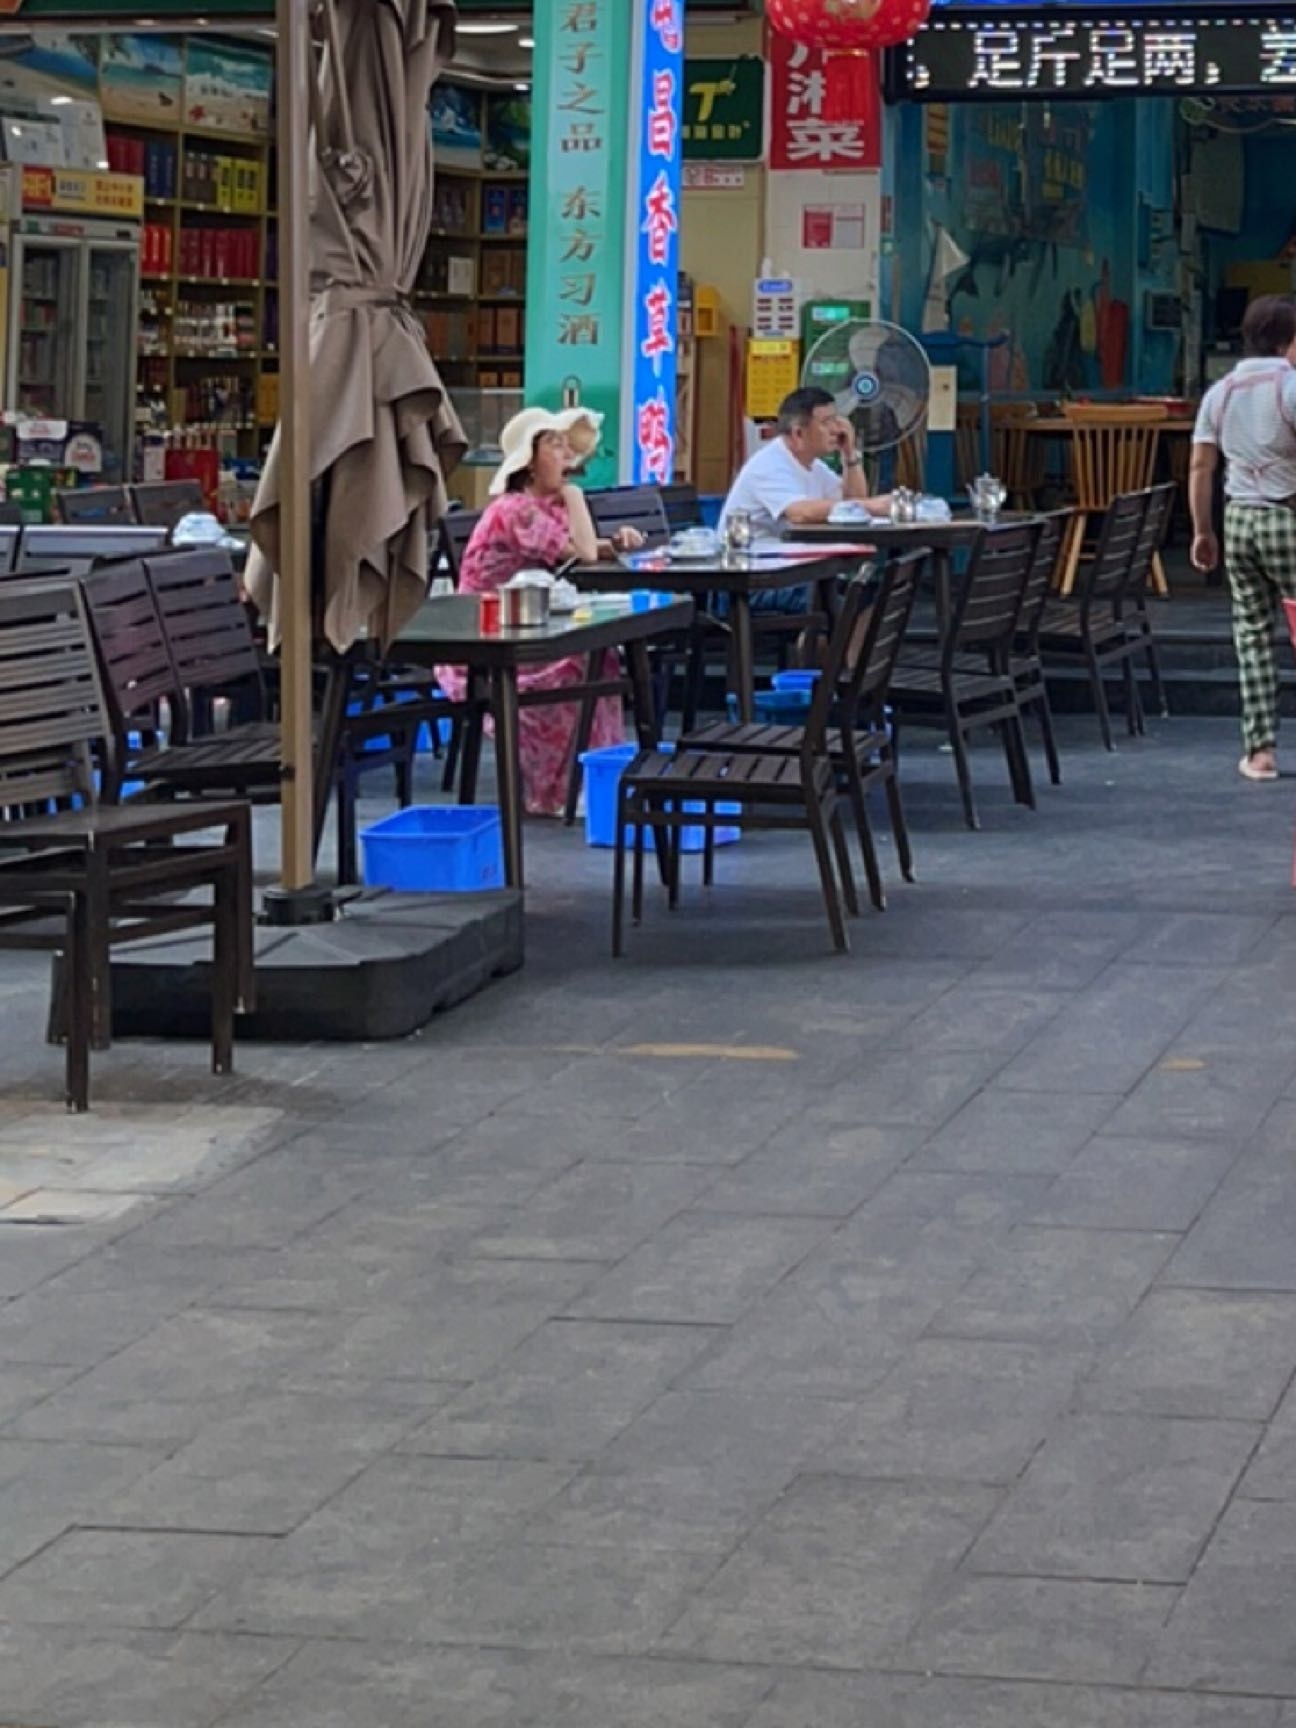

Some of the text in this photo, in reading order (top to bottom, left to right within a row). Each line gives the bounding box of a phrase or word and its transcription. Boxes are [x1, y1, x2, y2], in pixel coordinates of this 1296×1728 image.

[556, 0, 606, 154] 君子之品
[556, 184, 606, 345] 东方习酒
